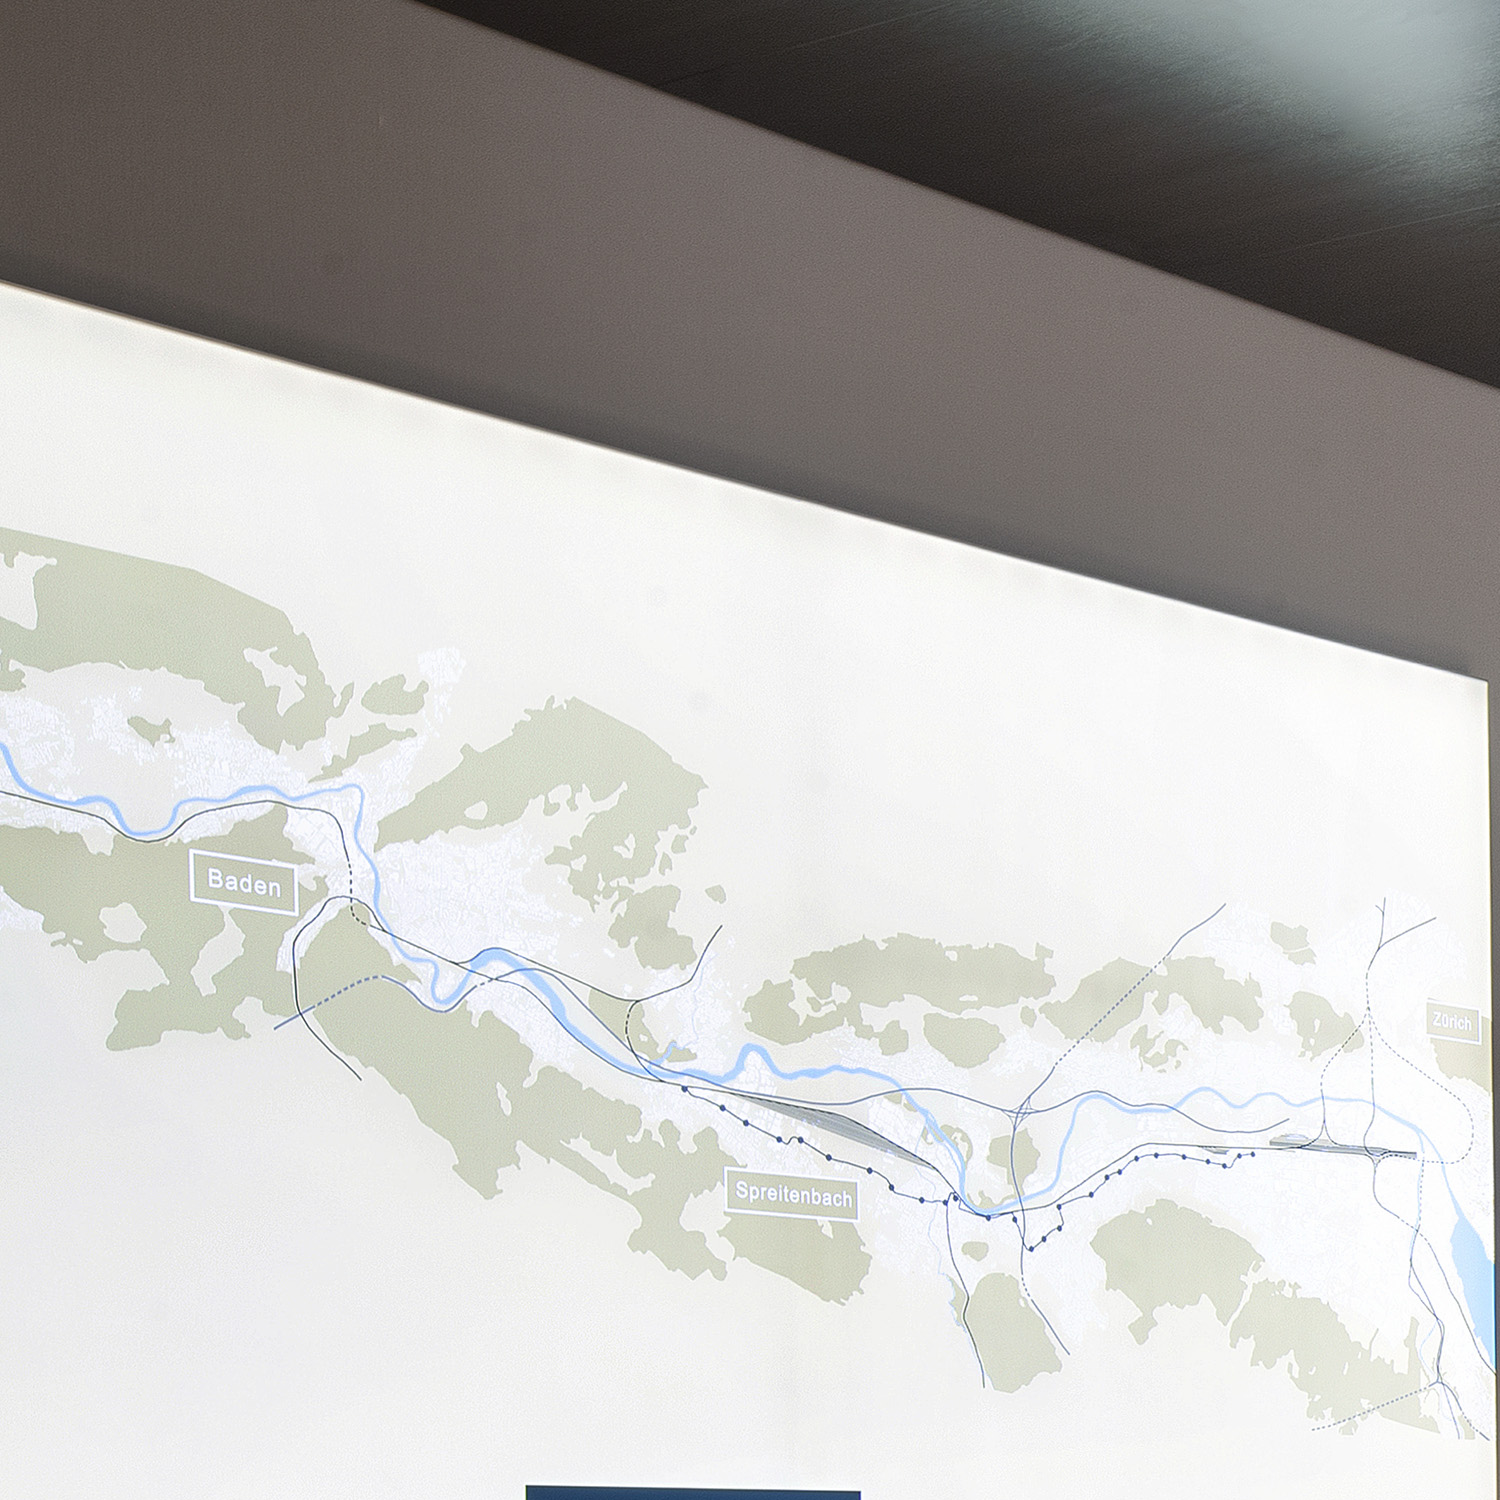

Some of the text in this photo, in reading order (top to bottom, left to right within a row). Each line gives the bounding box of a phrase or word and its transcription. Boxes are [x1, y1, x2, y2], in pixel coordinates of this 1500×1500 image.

[207, 867, 281, 898] Baden
[1432, 1010, 1472, 1031] Zürich
[735, 1180, 853, 1209] Spreitenbach
